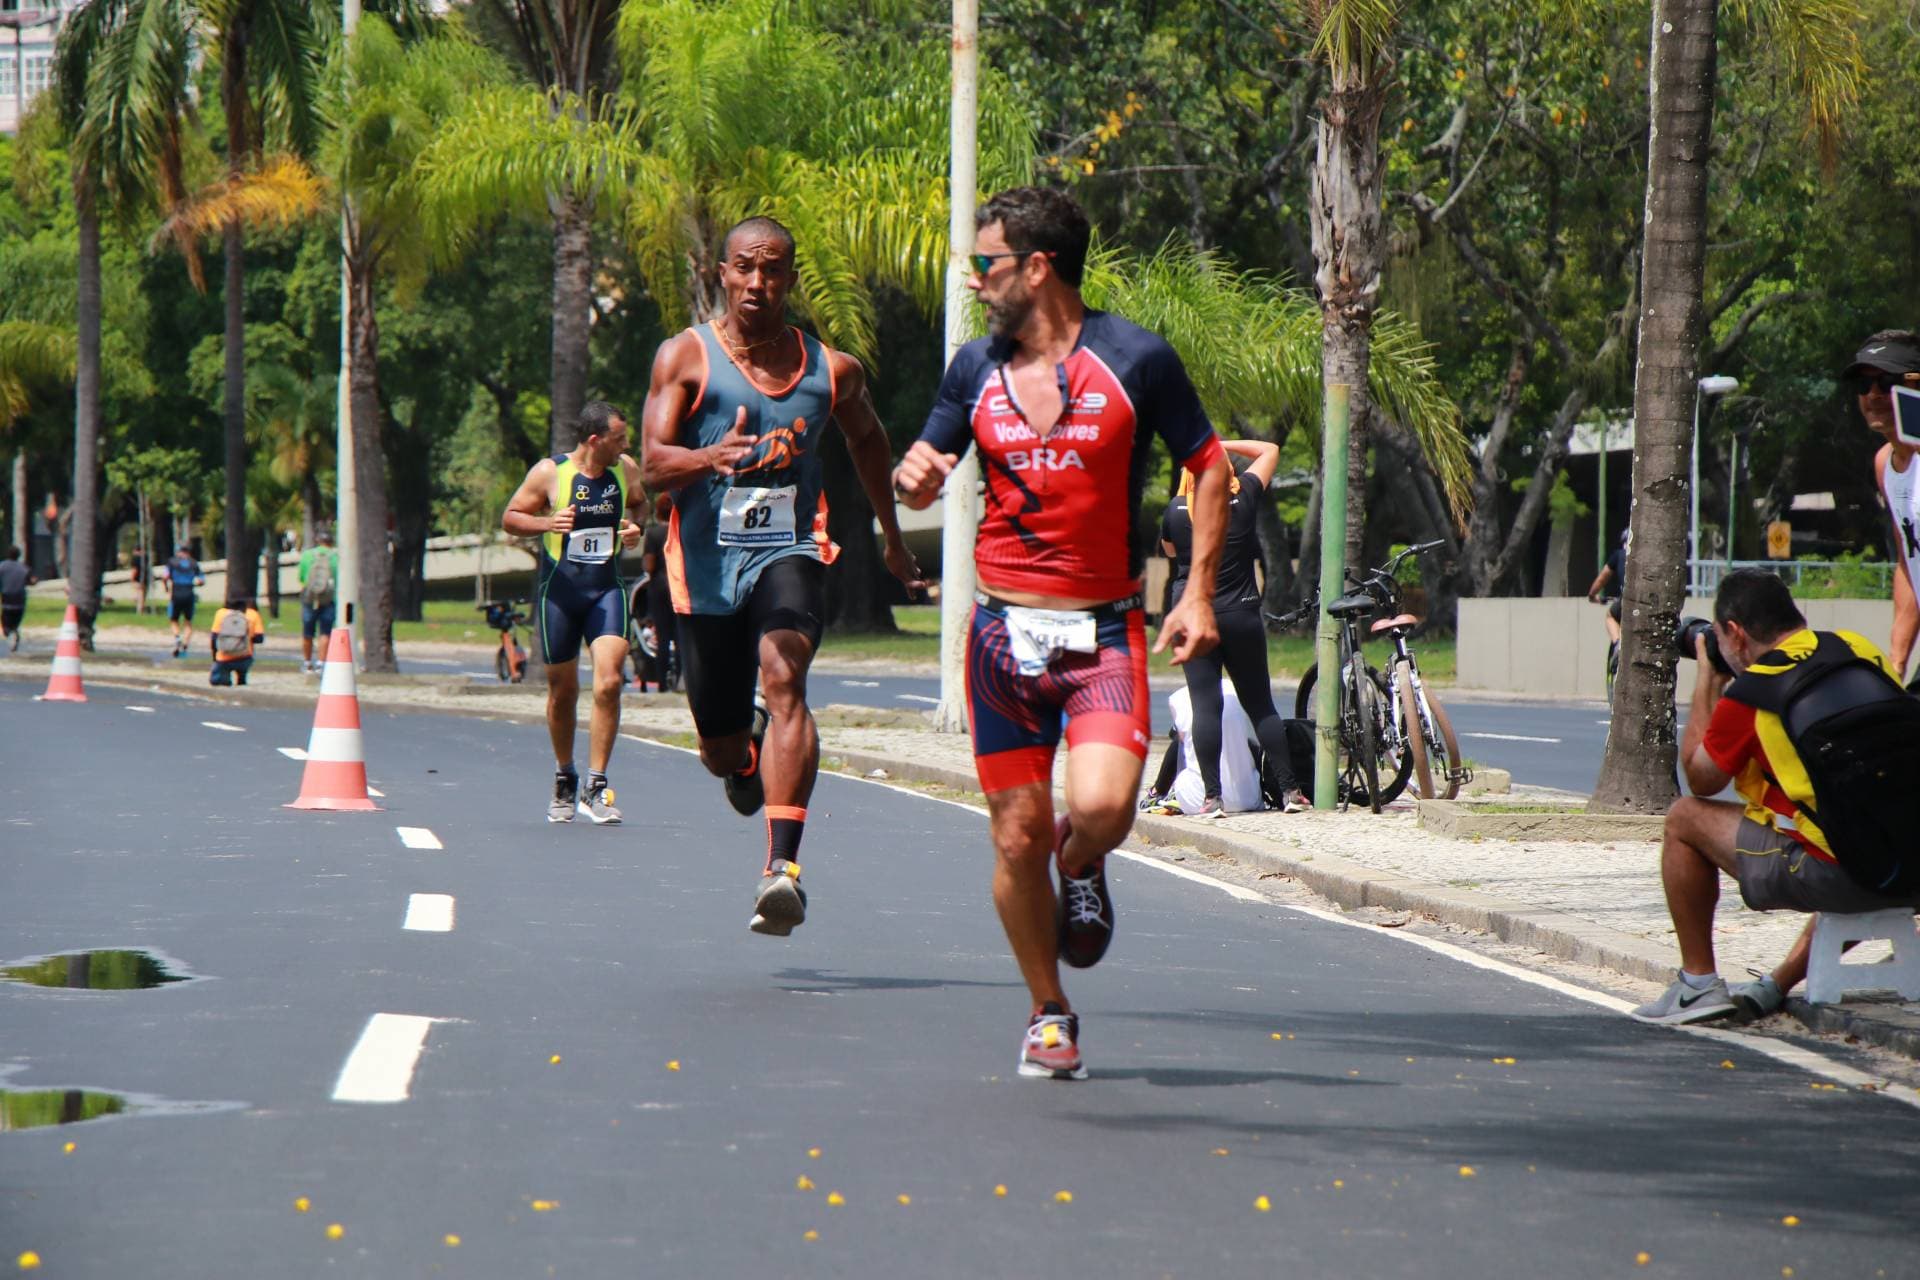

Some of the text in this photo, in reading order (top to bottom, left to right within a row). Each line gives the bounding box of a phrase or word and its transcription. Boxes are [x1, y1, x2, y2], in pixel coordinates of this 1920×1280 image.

[1005, 448, 1085, 471] BRA
[744, 506, 772, 529] 82
[583, 538, 598, 553] 81
